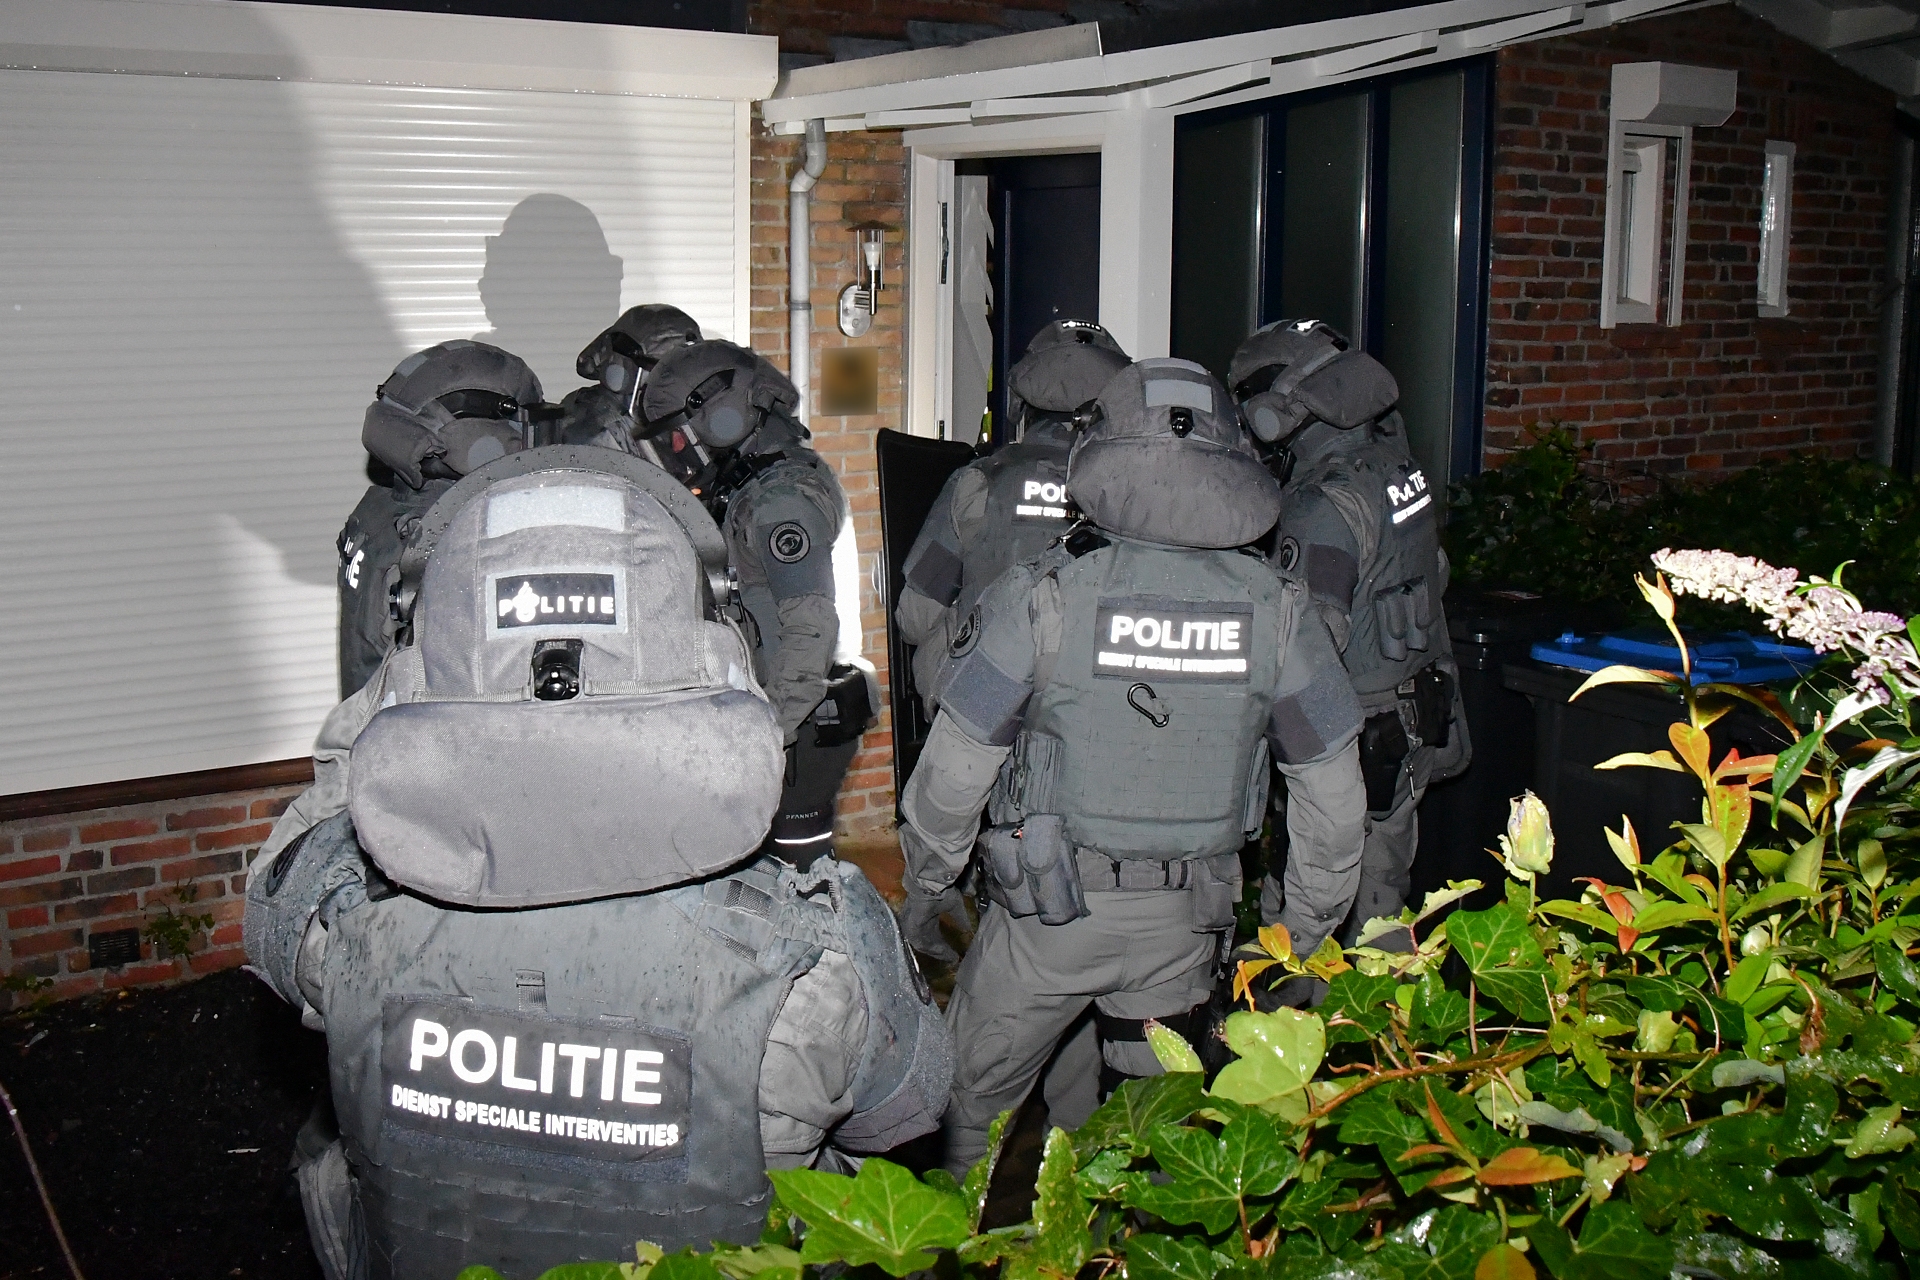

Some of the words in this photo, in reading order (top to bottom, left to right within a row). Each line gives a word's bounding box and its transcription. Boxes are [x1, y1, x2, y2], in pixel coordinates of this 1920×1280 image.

[1110, 615, 1240, 650] POLITIE
[410, 1018, 664, 1104] POLITIE
[391, 1084, 452, 1118] DIENST
[455, 1100, 541, 1133] SPECIALE
[545, 1114, 679, 1147] INTERVENTIES
